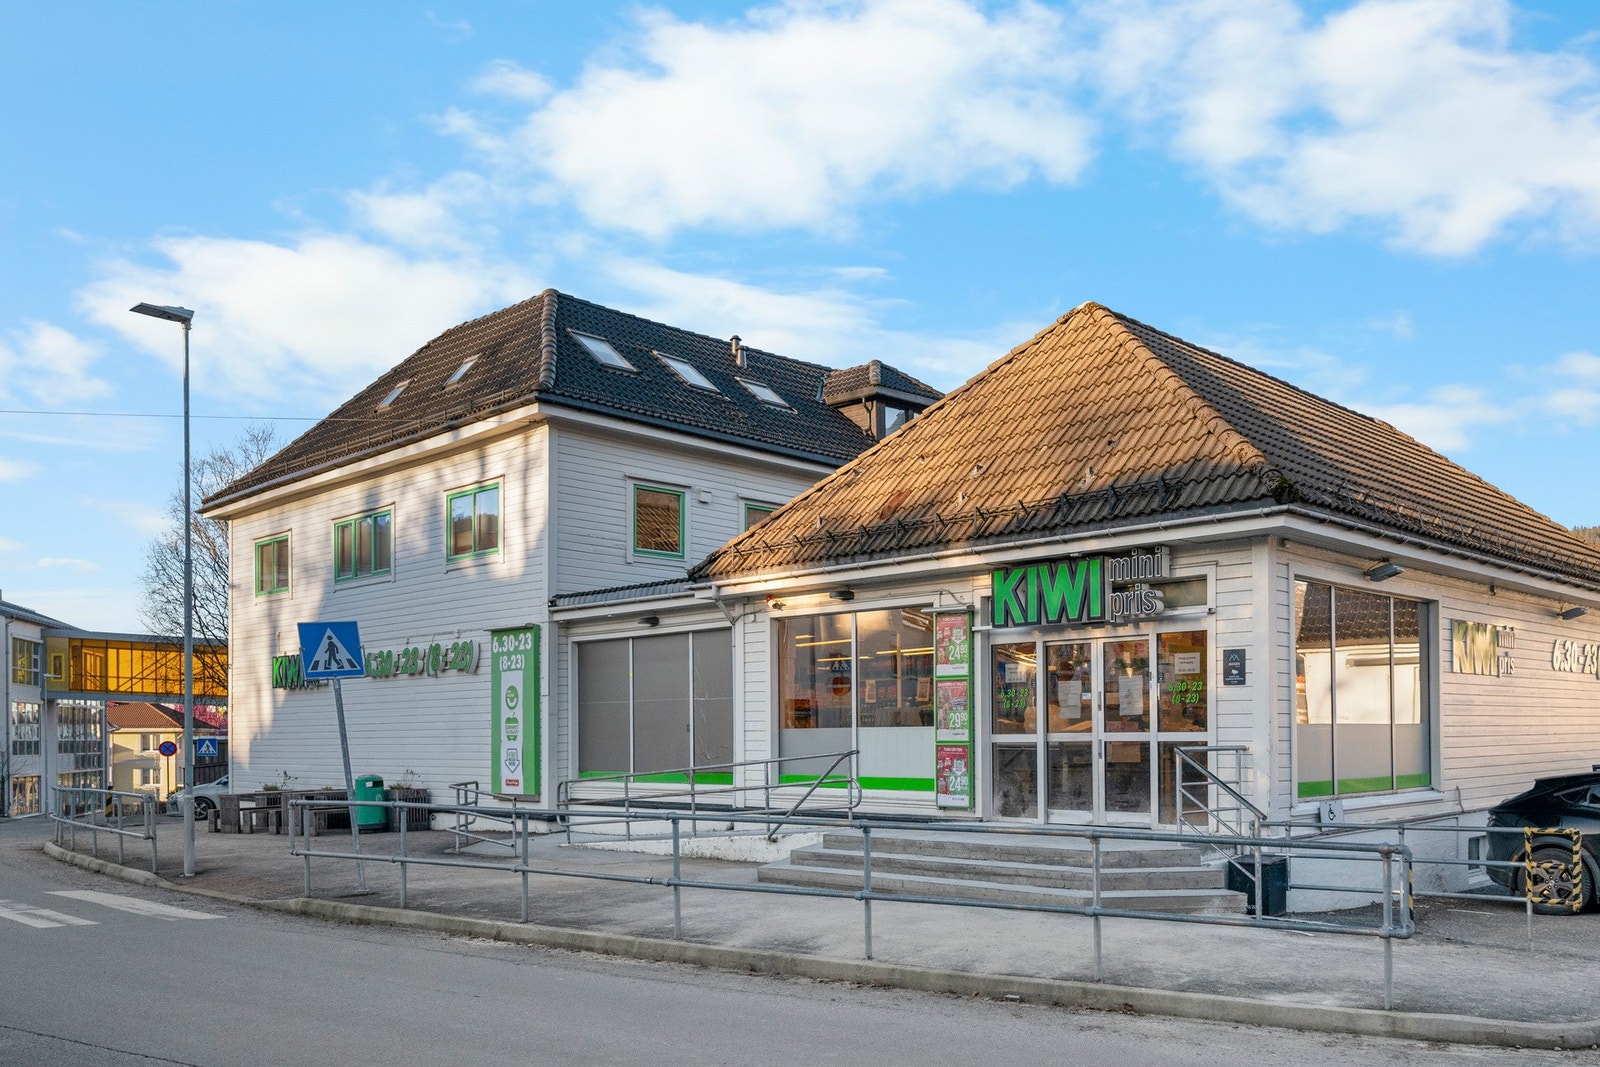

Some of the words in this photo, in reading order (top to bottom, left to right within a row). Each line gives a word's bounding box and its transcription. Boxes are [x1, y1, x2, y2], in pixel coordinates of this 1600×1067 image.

[992, 557, 1104, 627] KIWI
[1109, 546, 1163, 582] mini
[1110, 583, 1157, 623] pris
[492, 632, 532, 653] 6.30-23
[1451, 620, 1498, 675] KIWI
[500, 654, 525, 671] (8-23)
[1499, 651, 1516, 678] pris
